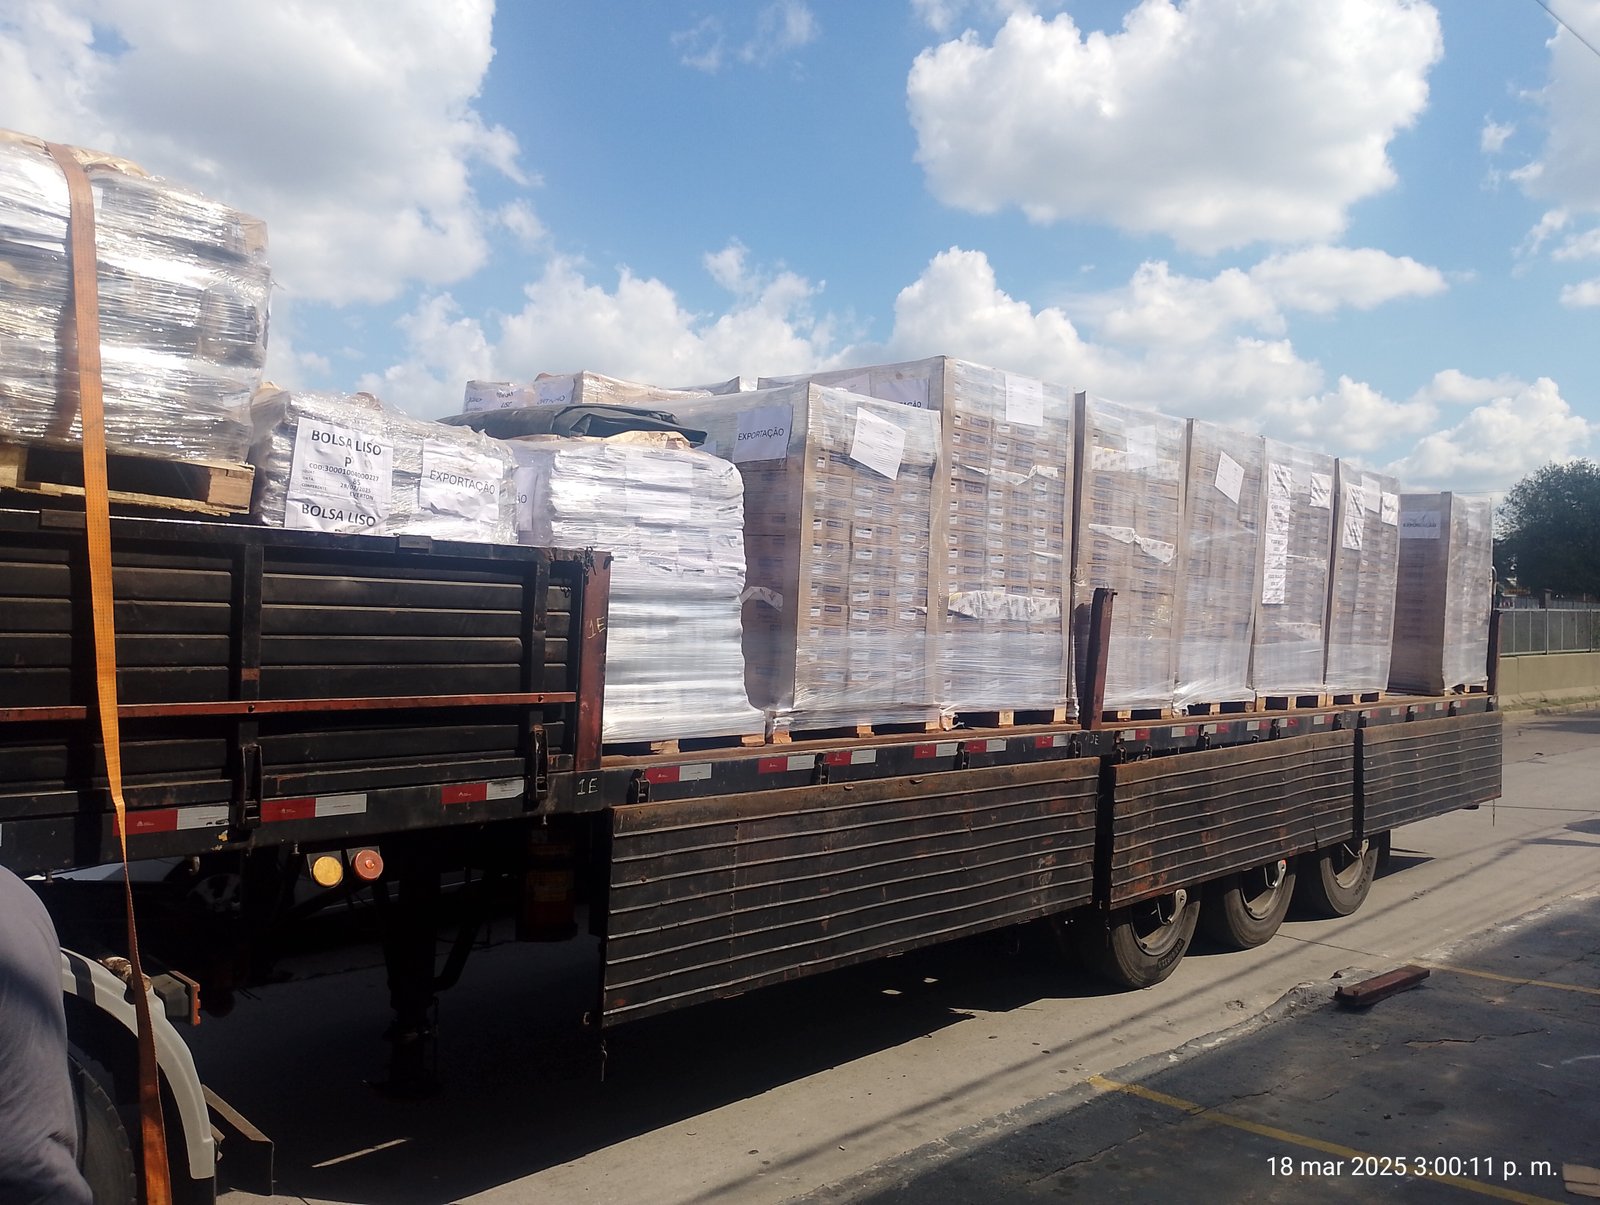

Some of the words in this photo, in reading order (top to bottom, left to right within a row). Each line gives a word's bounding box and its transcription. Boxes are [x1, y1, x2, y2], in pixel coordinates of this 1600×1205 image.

[311, 430, 353, 450] BOLSA
[355, 440, 382, 456] LISO
[738, 428, 785, 441] EXPORTAÇÃO
[344, 456, 352, 467] P
[429, 470, 496, 495] EXPORTAÇÃO
[302, 504, 344, 521] BOLSA
[348, 512, 376, 527] LISO
[577, 777, 599, 796] 1E
